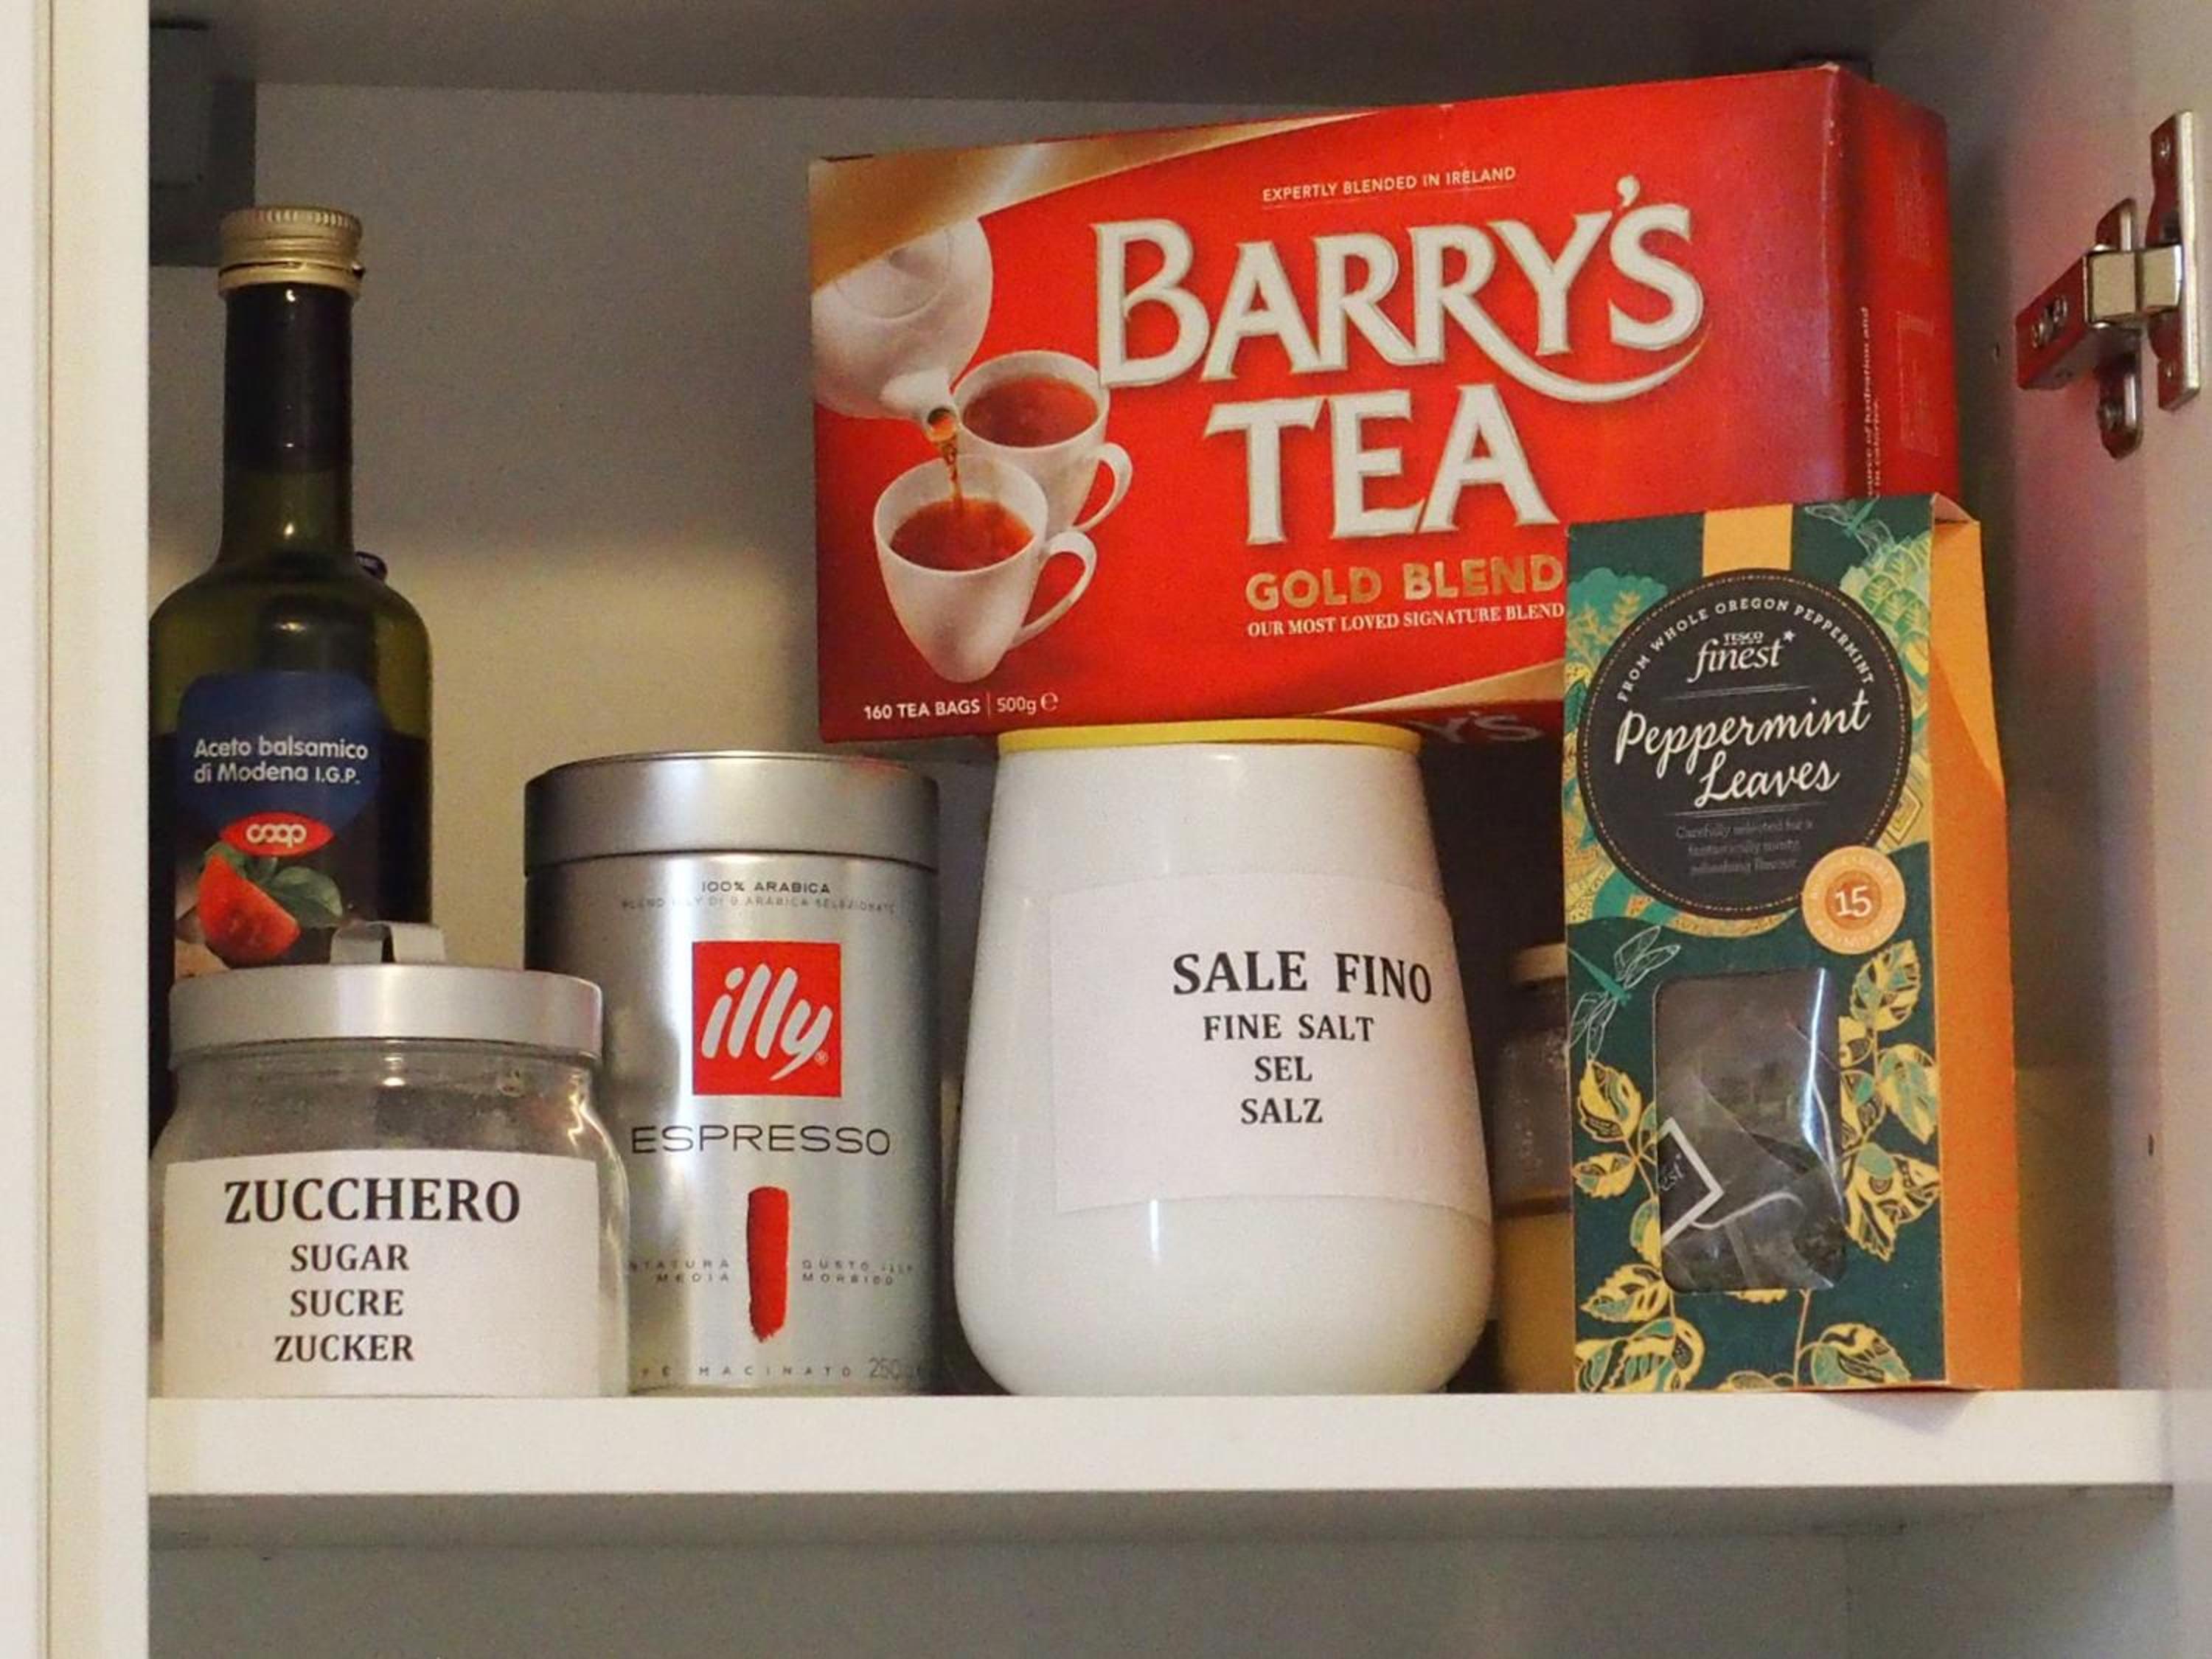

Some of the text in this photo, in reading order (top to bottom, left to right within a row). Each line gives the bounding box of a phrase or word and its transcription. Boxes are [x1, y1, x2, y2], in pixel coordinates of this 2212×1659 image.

[1262, 166, 1516, 204] EXPERTLY BLENDED IN IRELAND
[1090, 175, 1711, 403] BARRY'S
[1203, 383, 1559, 546] TEA
[1245, 553, 1565, 611] GOLD BLEND
[1248, 602, 1565, 638] OUR MOST LOVED SIGNATURE BLEND
[1616, 597, 1875, 703] FROM WHOLE OREGON PEPPERMINT
[1686, 638, 1785, 684] finest
[863, 698, 981, 720] 160 TEA BAGS
[996, 695, 1037, 715] 500g
[193, 735, 369, 761] Aceto balsamico
[1613, 689, 1873, 779] Peppermint
[193, 763, 212, 784] di
[216, 762, 309, 782] Modena
[1694, 750, 1840, 809] Leaves
[246, 823, 307, 848] coop
[701, 880, 831, 894] 100% ARABICA
[1834, 885, 1873, 918] 15
[1172, 950, 1433, 1004] SALE FINO
[700, 961, 835, 1082] illy
[1203, 1013, 1374, 1042] FINE SALT
[1254, 1055, 1313, 1082] SEL
[1240, 1097, 1323, 1124] SALZ
[631, 1124, 891, 1156] ESPRESSO
[223, 1177, 521, 1225] ZUCCHERO
[290, 1243, 410, 1273] SUGAR
[289, 1289, 405, 1318] SUCRE
[274, 1334, 415, 1363] ZUCKER
